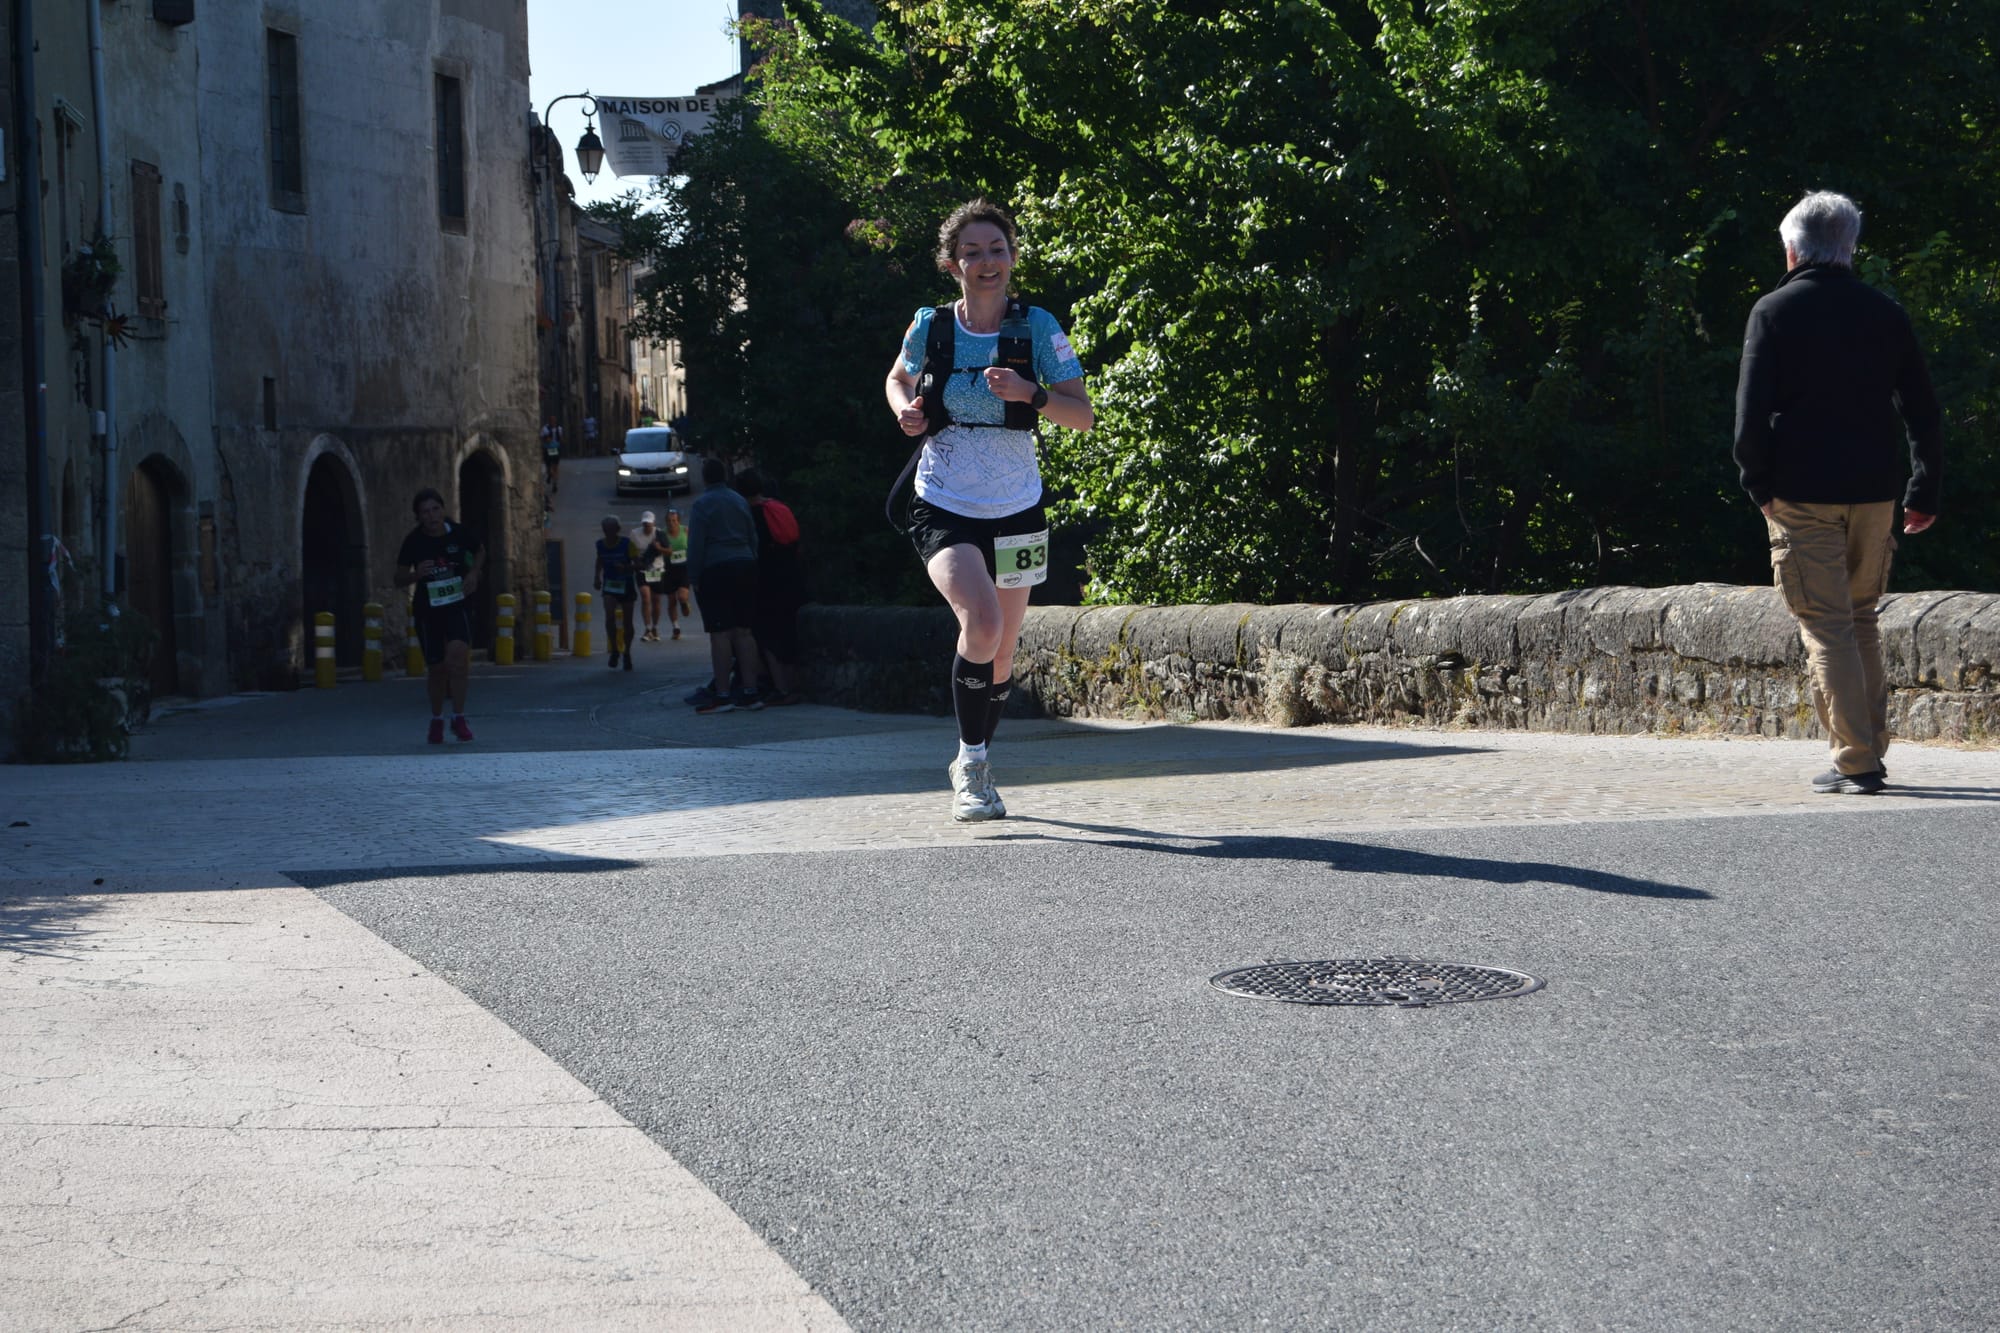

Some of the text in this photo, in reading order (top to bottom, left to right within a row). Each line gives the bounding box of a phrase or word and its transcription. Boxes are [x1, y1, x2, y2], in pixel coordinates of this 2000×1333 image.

[602, 99, 680, 115] MAISON
[686, 98, 711, 112] DE
[1015, 545, 1047, 570] 83
[438, 585, 455, 597] 89
